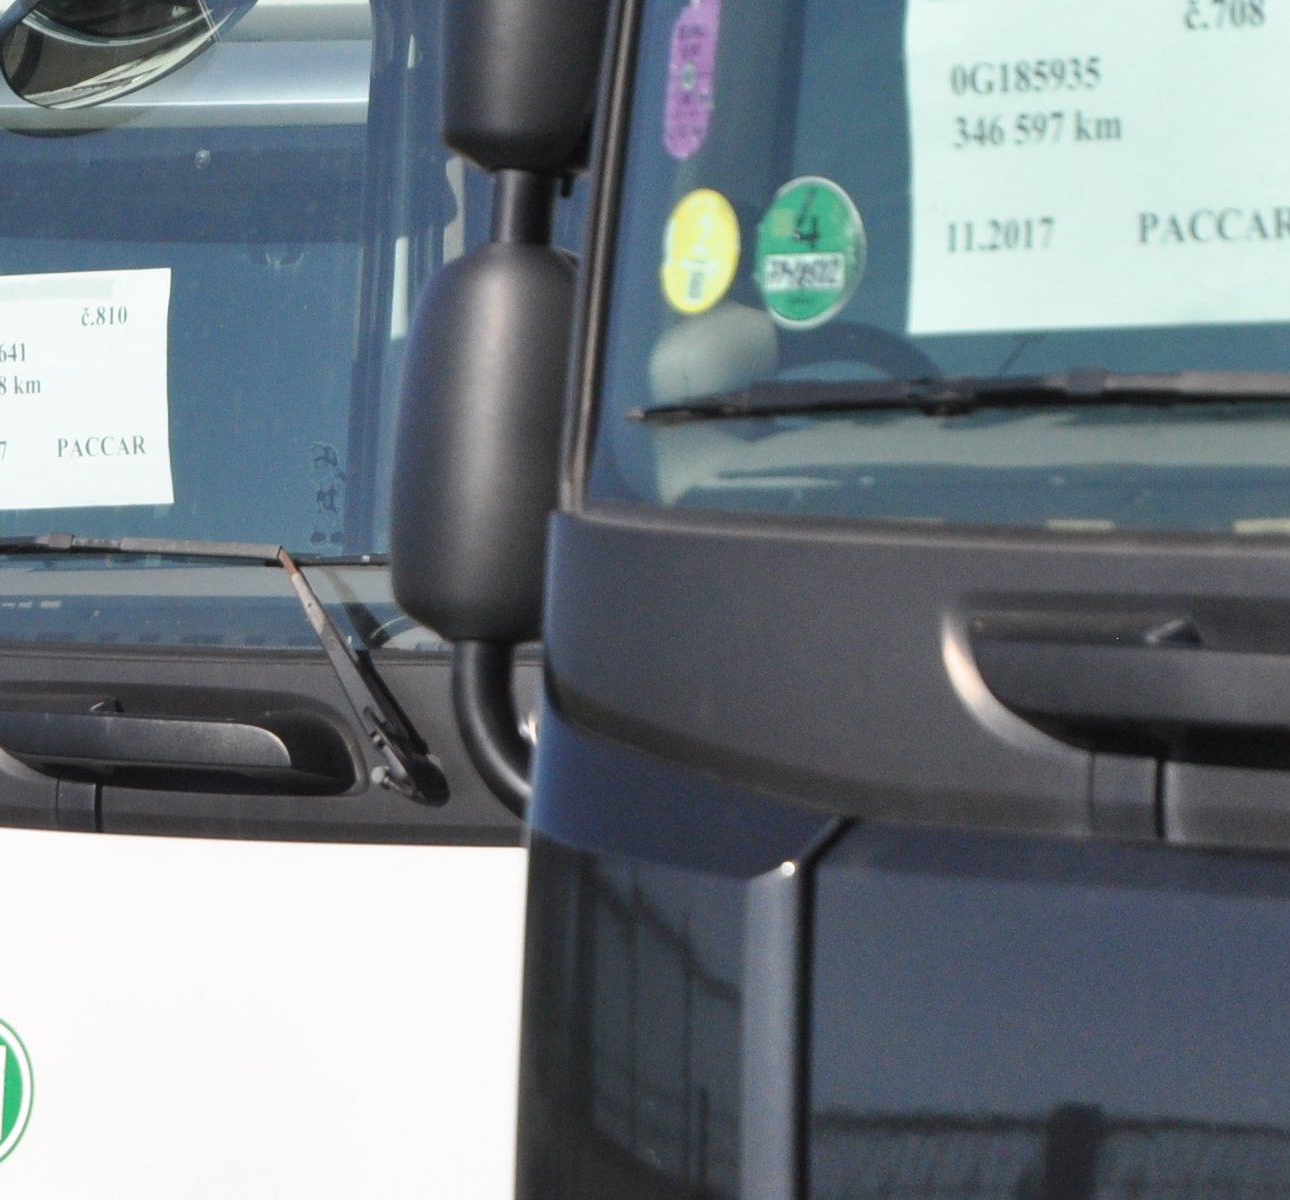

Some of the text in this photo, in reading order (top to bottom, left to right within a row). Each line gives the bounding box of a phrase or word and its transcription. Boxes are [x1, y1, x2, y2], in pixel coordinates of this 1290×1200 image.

[950, 56, 1101, 96] 0G185935
[954, 110, 1123, 149] 346 597 km
[946, 216, 1056, 253] 11.2017
[81, 305, 128, 327] č.810
[13, 375, 42, 395] km
[57, 435, 147, 458] PACCAR
